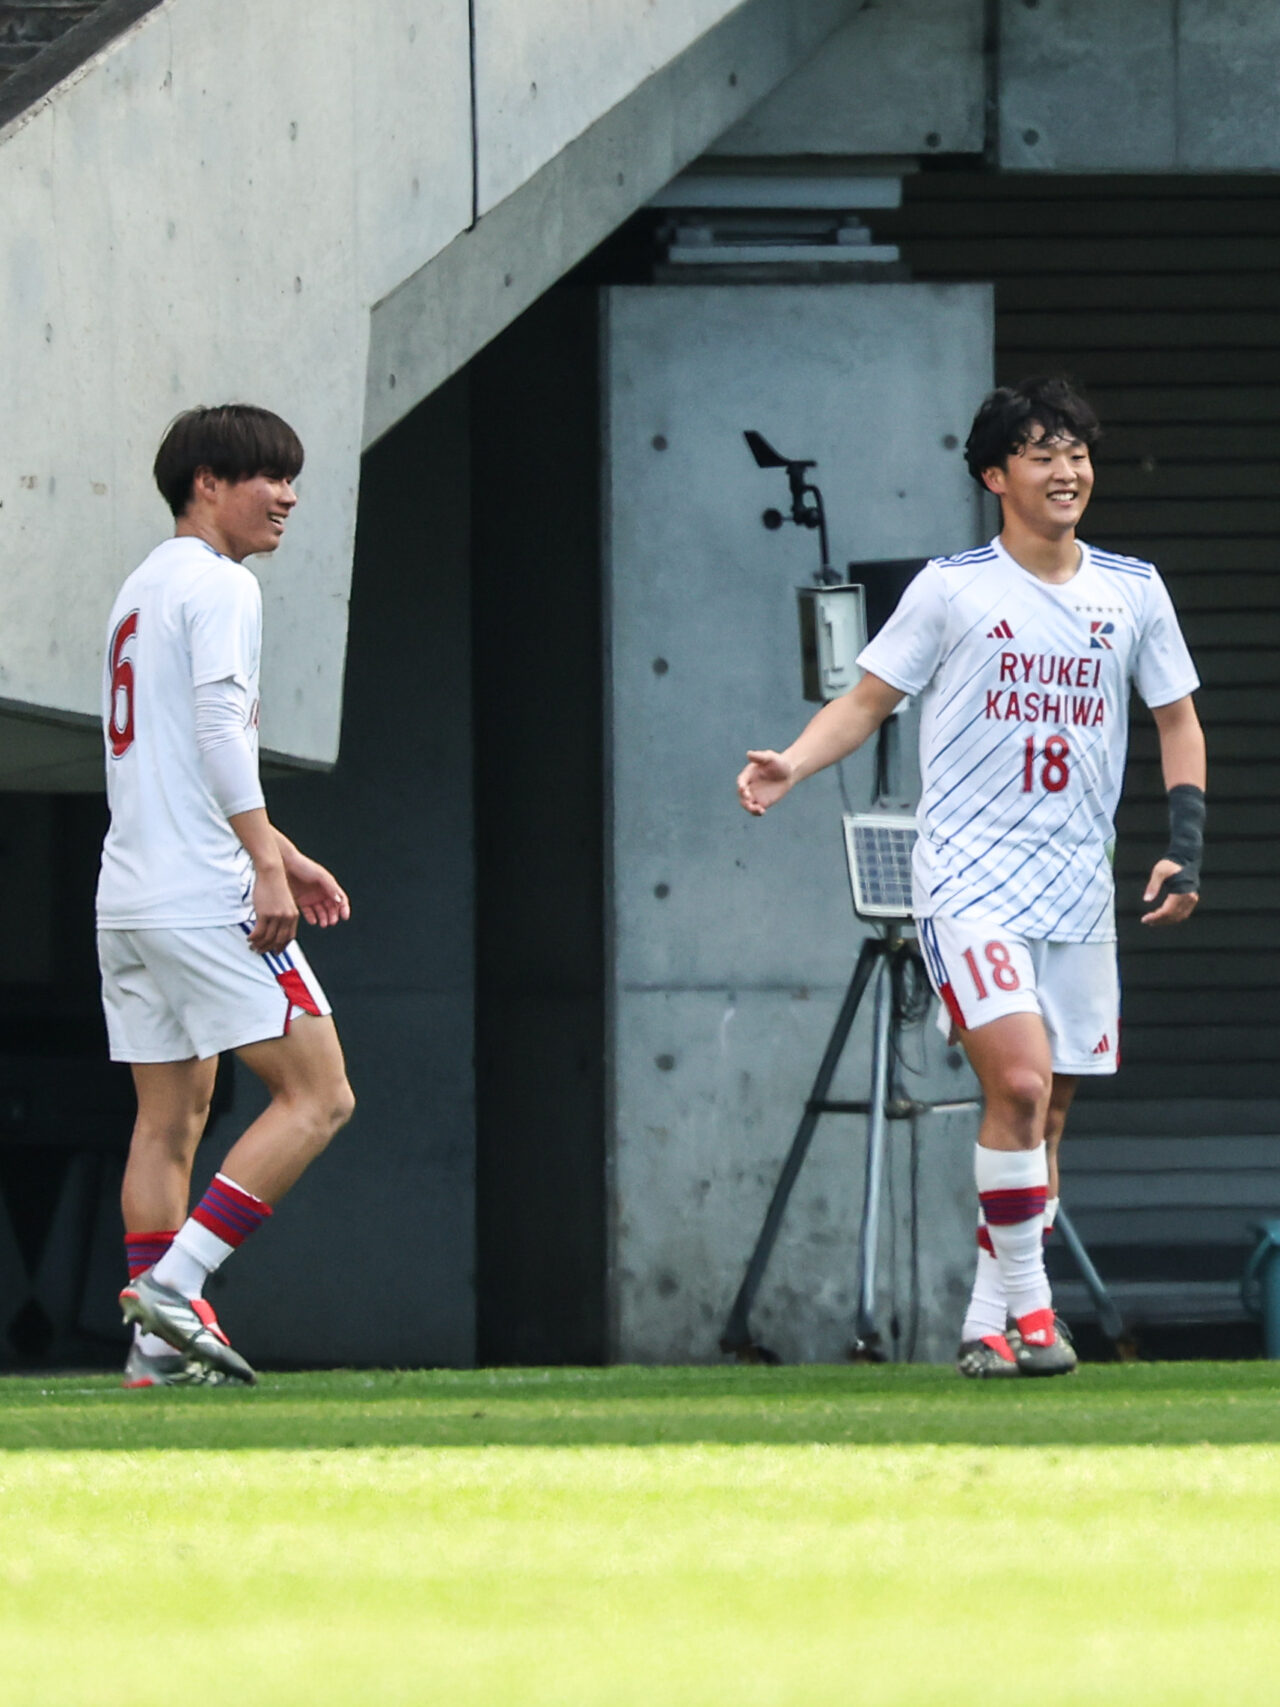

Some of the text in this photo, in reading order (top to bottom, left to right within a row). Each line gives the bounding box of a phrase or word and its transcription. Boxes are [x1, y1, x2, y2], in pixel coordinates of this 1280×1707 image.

[109, 608, 140, 760] 6
[1000, 652, 1101, 689] RYUKEI
[986, 689, 1105, 727] KASHIWA
[1022, 733, 1070, 794] 18
[962, 940, 1021, 1001] 18
